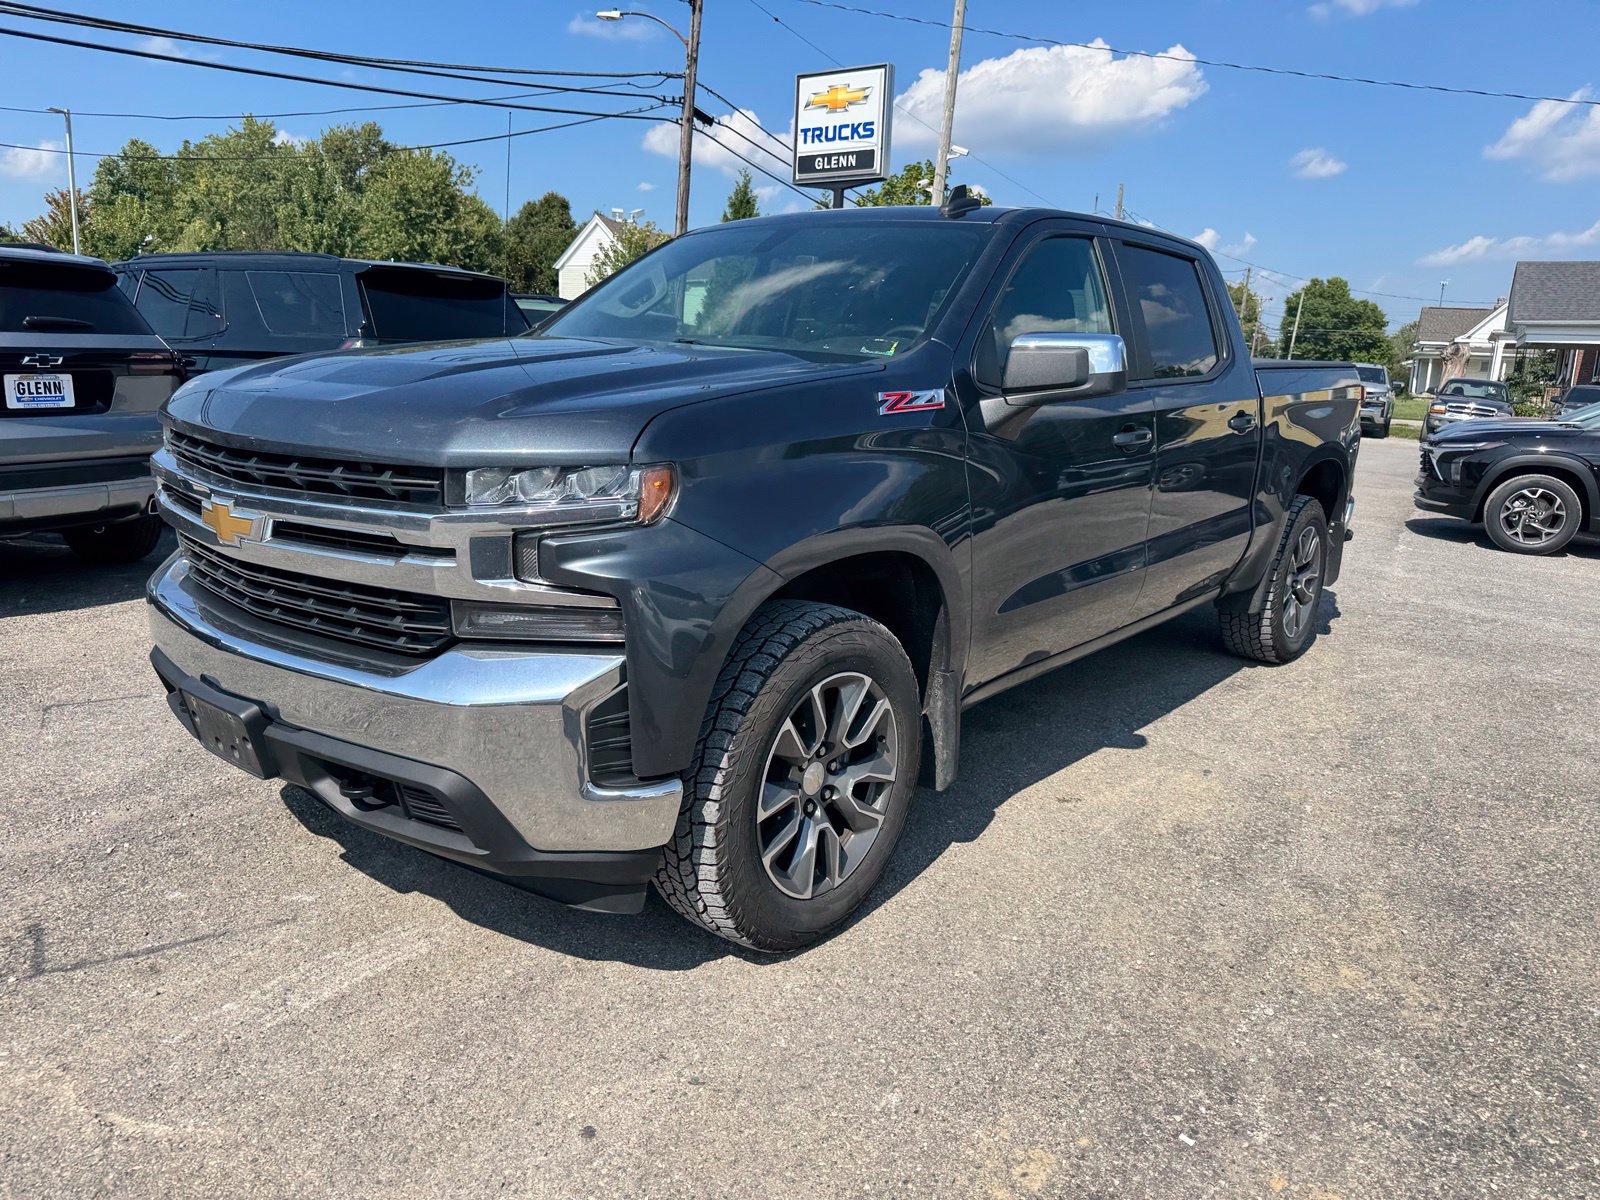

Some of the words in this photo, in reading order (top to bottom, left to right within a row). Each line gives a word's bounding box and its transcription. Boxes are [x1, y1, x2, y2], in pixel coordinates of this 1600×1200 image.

[800, 121, 875, 144] TRUCKS
[815, 154, 856, 169] GLENN
[16, 381, 62, 395] GLENN
